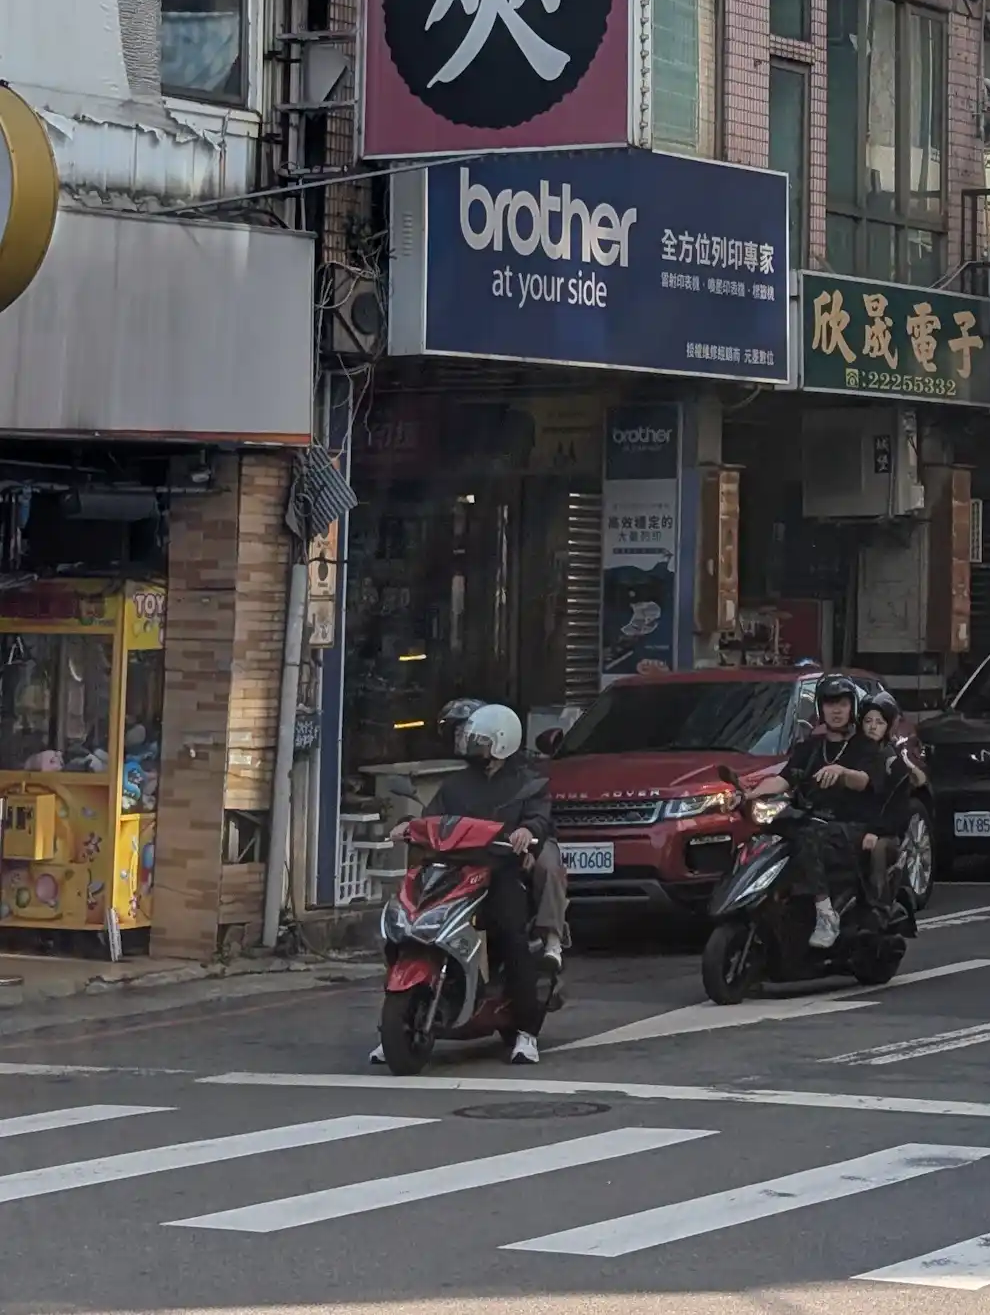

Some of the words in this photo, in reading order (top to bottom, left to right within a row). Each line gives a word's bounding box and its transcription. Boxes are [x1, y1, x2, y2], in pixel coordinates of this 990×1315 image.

[459, 167, 637, 268] brother
[661, 228, 775, 275] 全方位列印專家
[491, 268, 513, 297] at
[518, 272, 564, 308] your
[568, 271, 608, 308] side
[812, 289, 984, 379] 欣晟電子
[612, 425, 673, 444] brother
[560, 851, 612, 869] MK-0608
